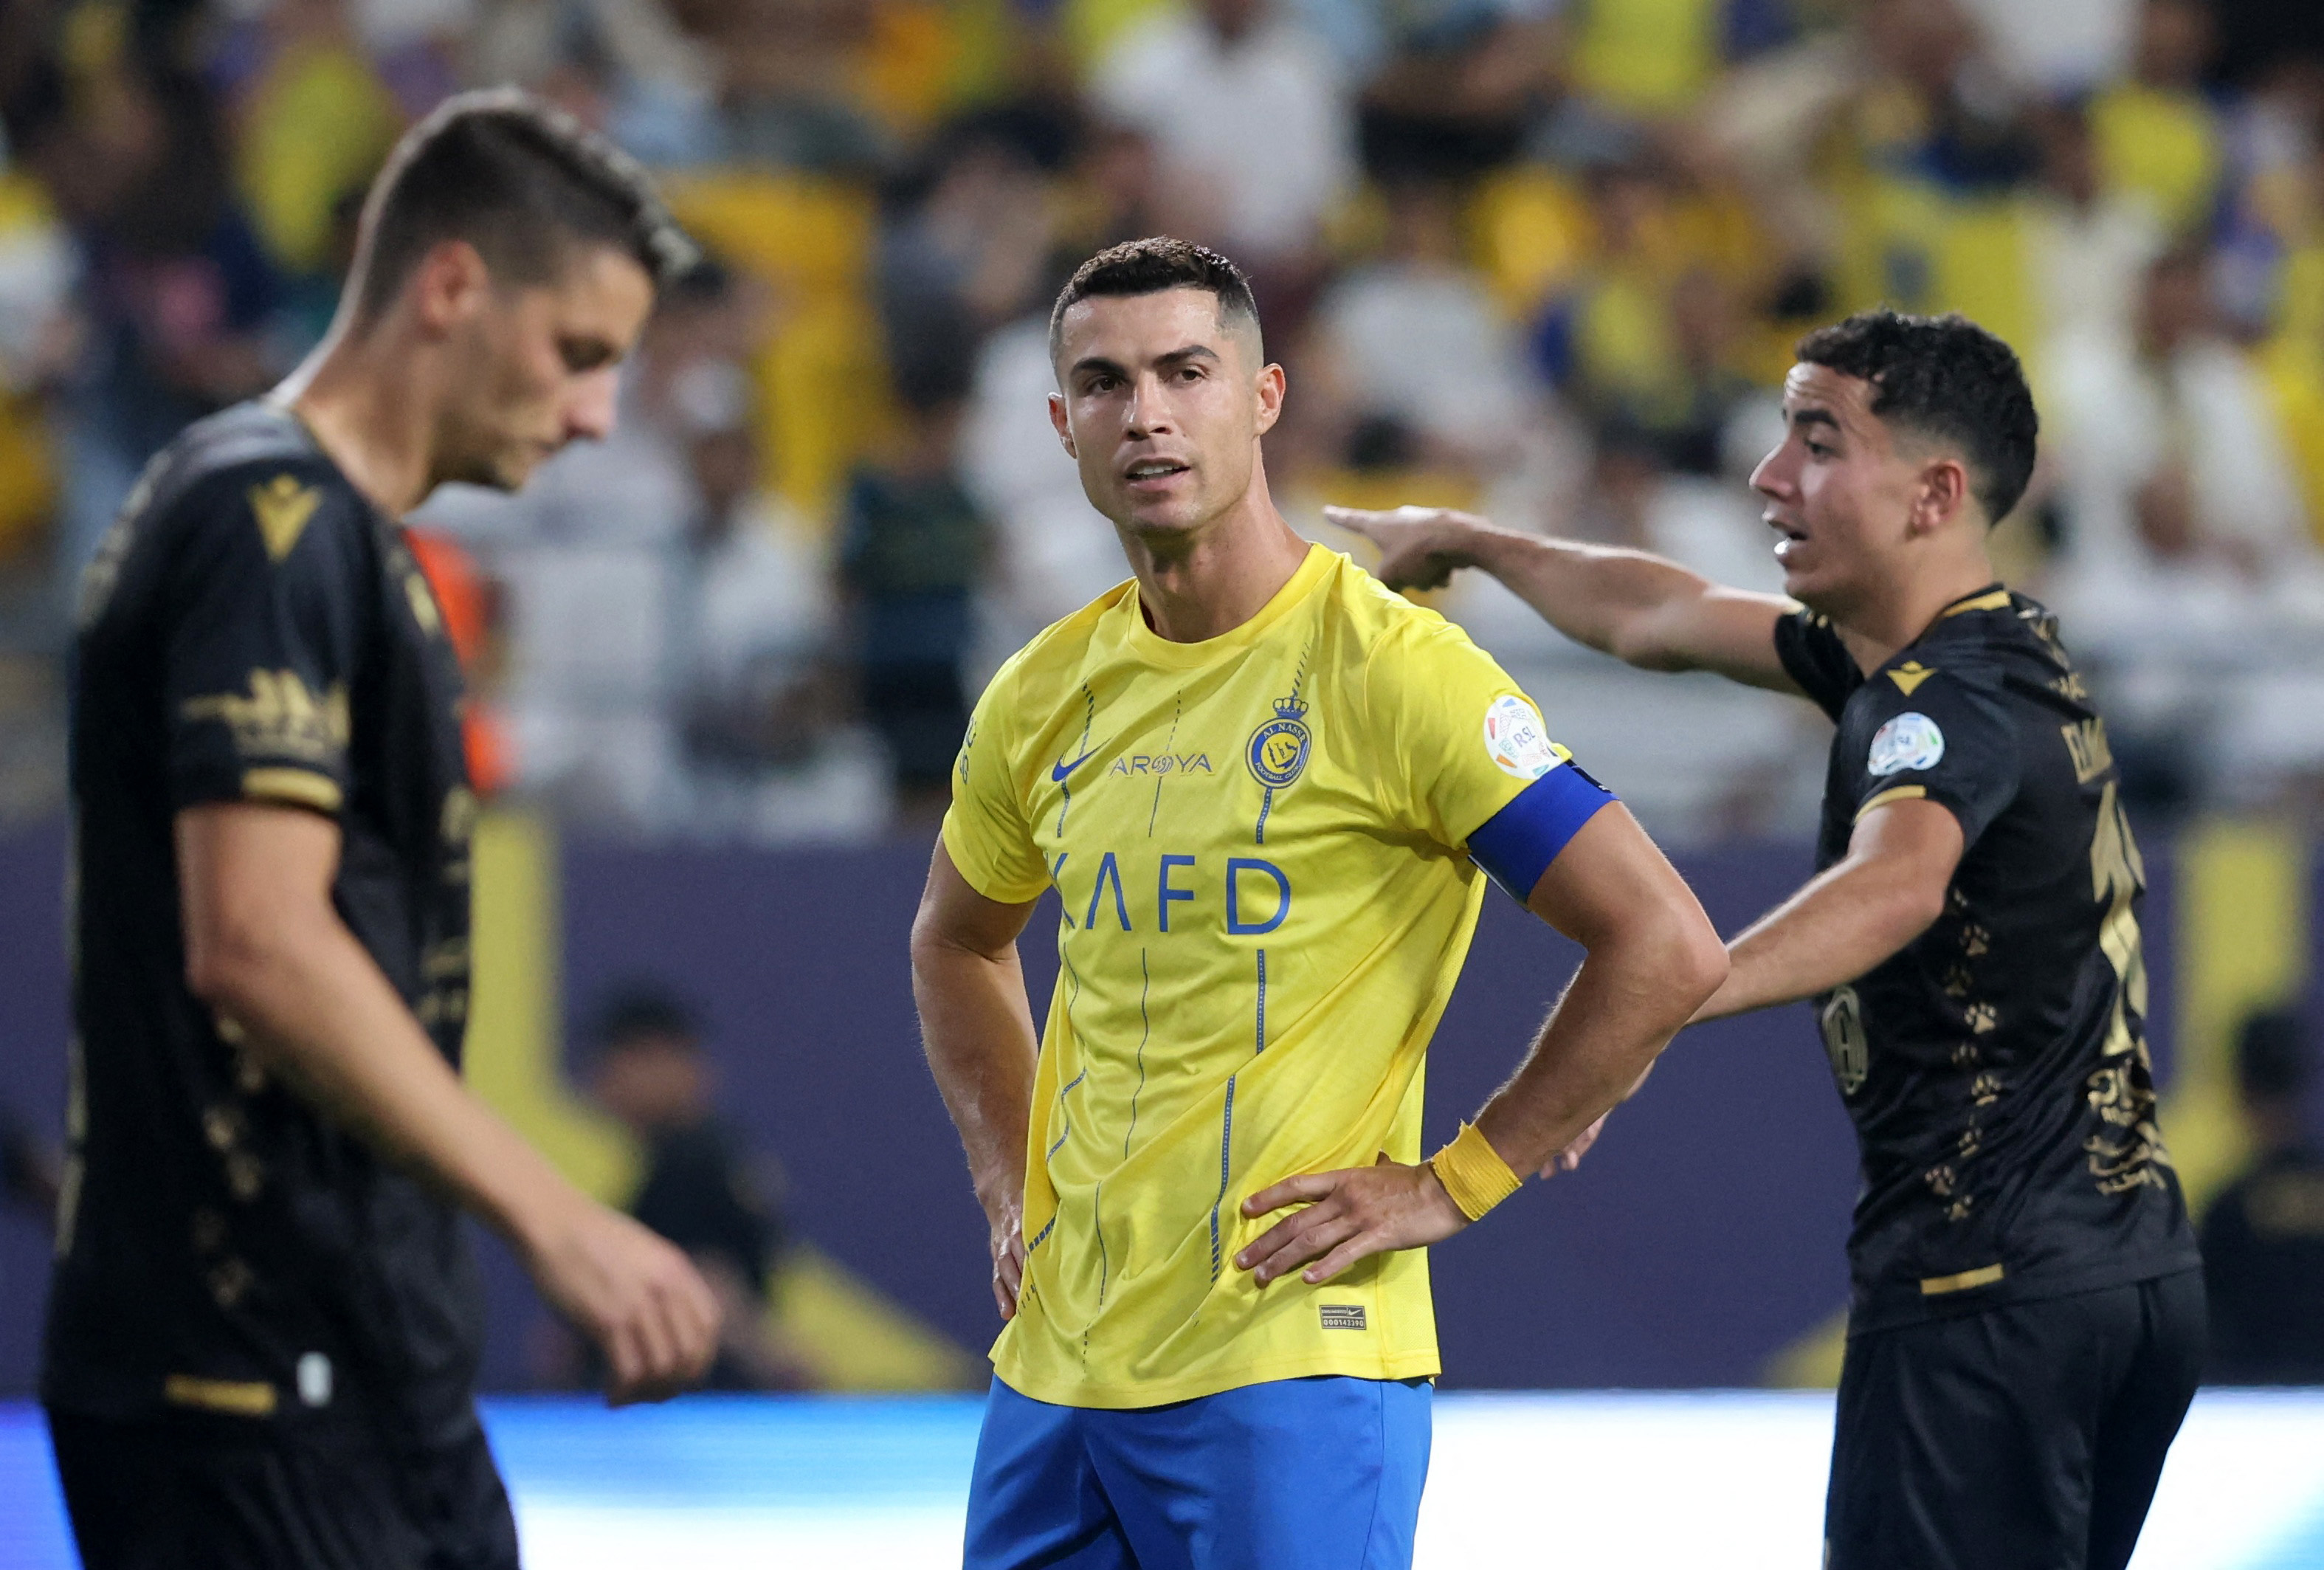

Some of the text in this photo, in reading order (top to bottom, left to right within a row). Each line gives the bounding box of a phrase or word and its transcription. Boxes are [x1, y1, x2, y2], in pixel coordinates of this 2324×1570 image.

[1263, 723, 1306, 743] AL NASSR
[1512, 726, 1536, 748] RSL
[1108, 753, 1213, 777] AROYA
